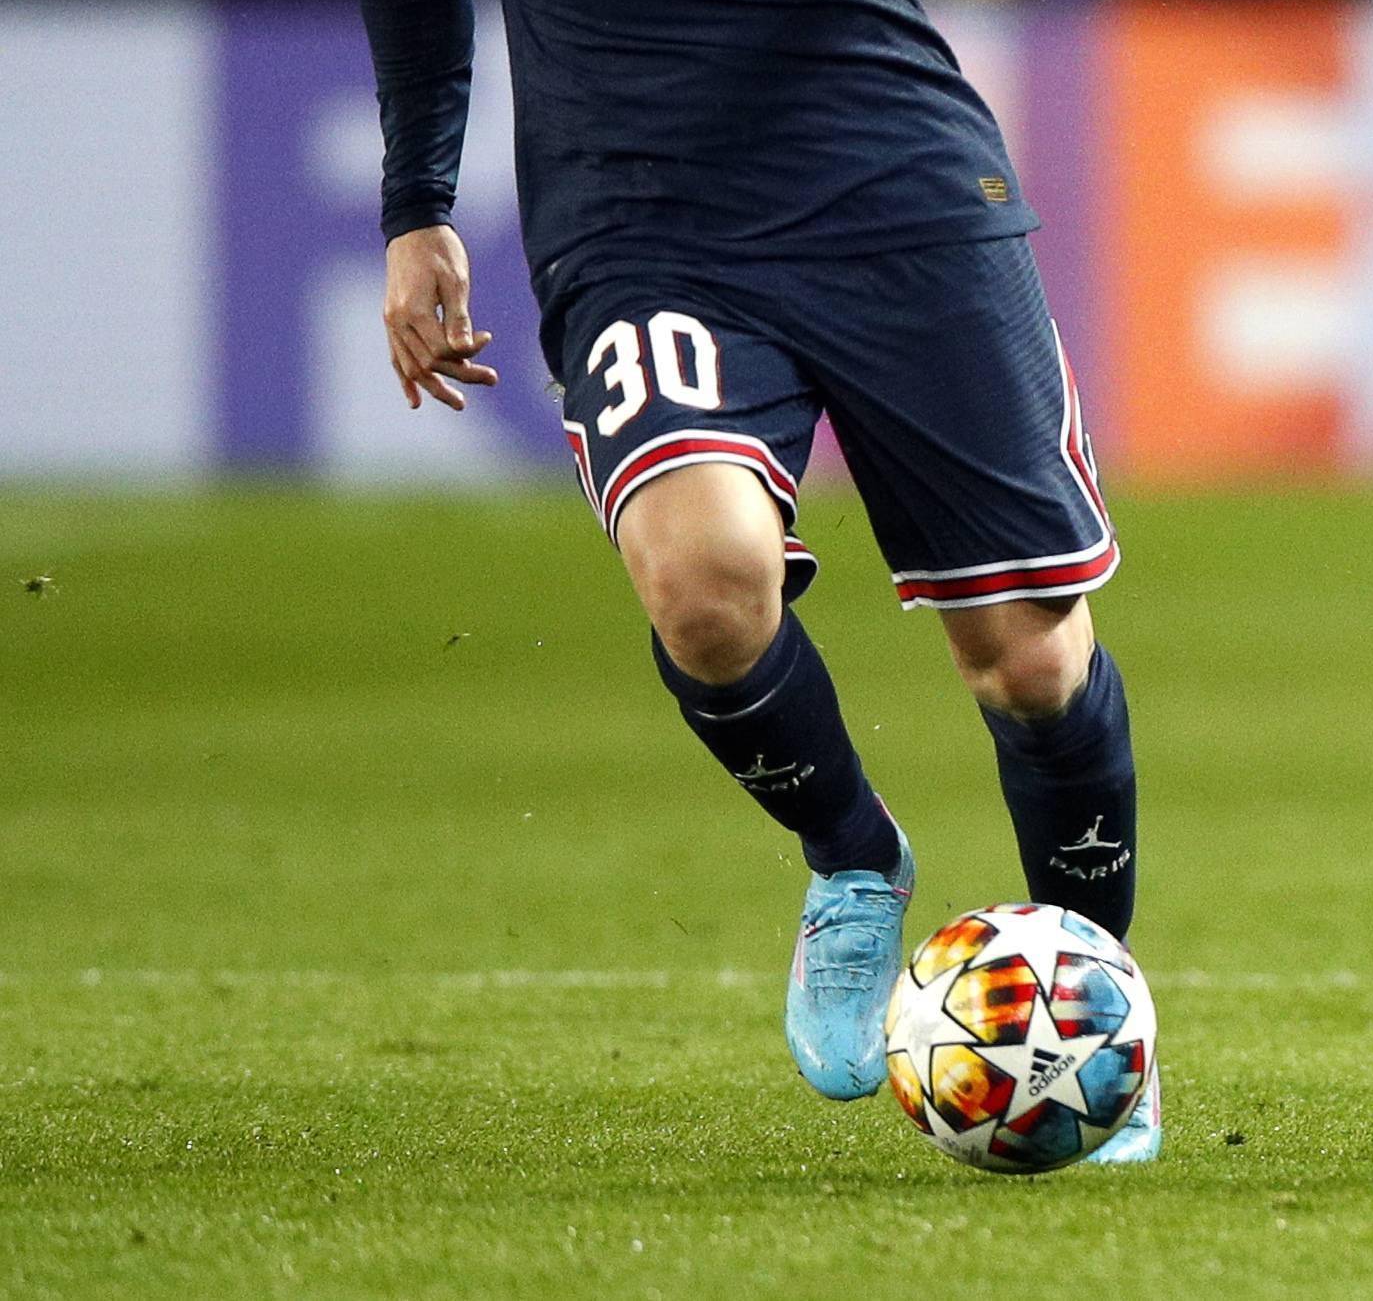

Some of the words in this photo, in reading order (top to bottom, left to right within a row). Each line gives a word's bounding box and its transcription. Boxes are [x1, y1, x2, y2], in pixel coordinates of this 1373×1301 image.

[586, 311, 726, 438] 30
[1049, 849, 1131, 881] PARIS
[1028, 1054, 1076, 1097] adidas
